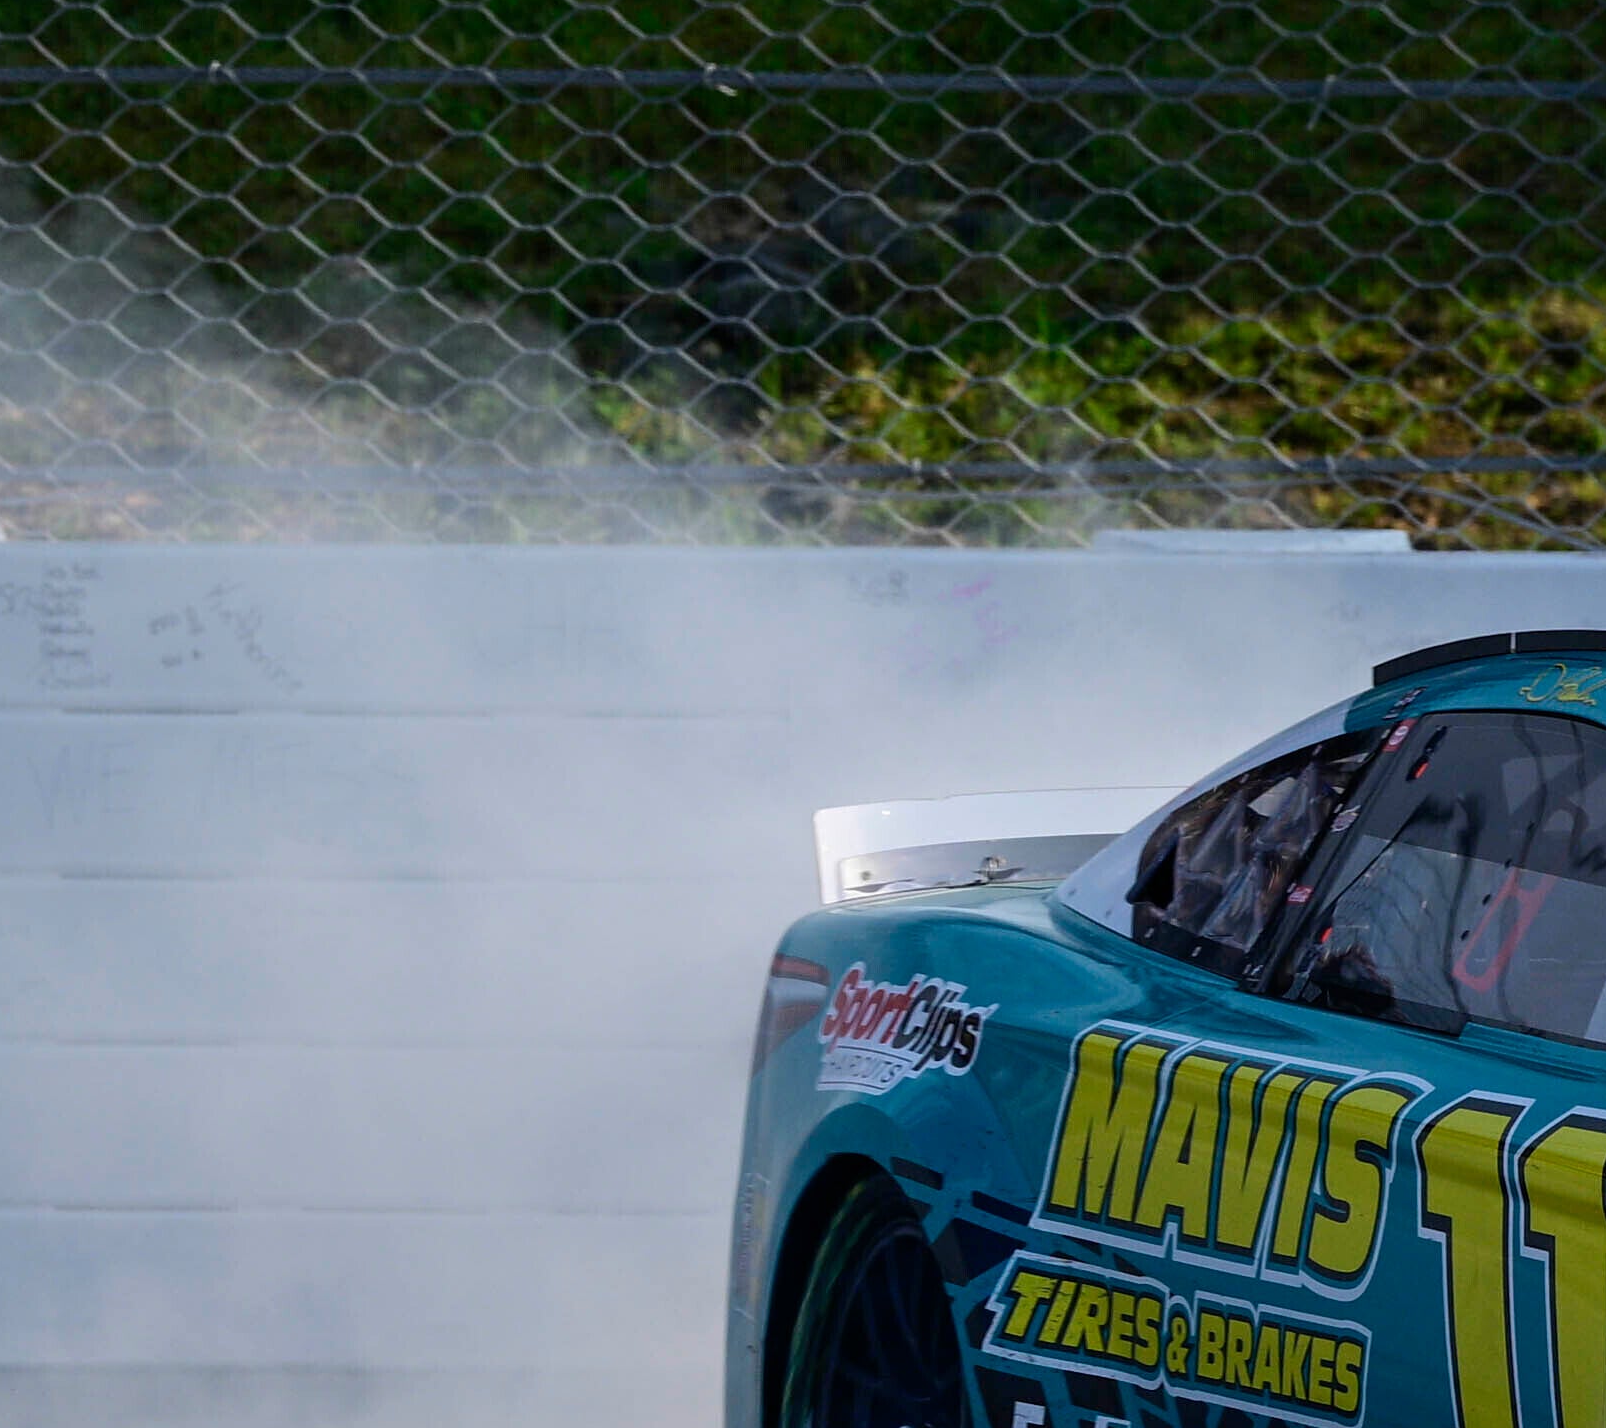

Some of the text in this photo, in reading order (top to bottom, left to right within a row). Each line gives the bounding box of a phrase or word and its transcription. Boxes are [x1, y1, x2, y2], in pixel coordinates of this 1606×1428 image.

[1042, 1029, 1418, 1285] MAVIS
[1002, 1271, 1365, 1416] TIRES & BRAKES
